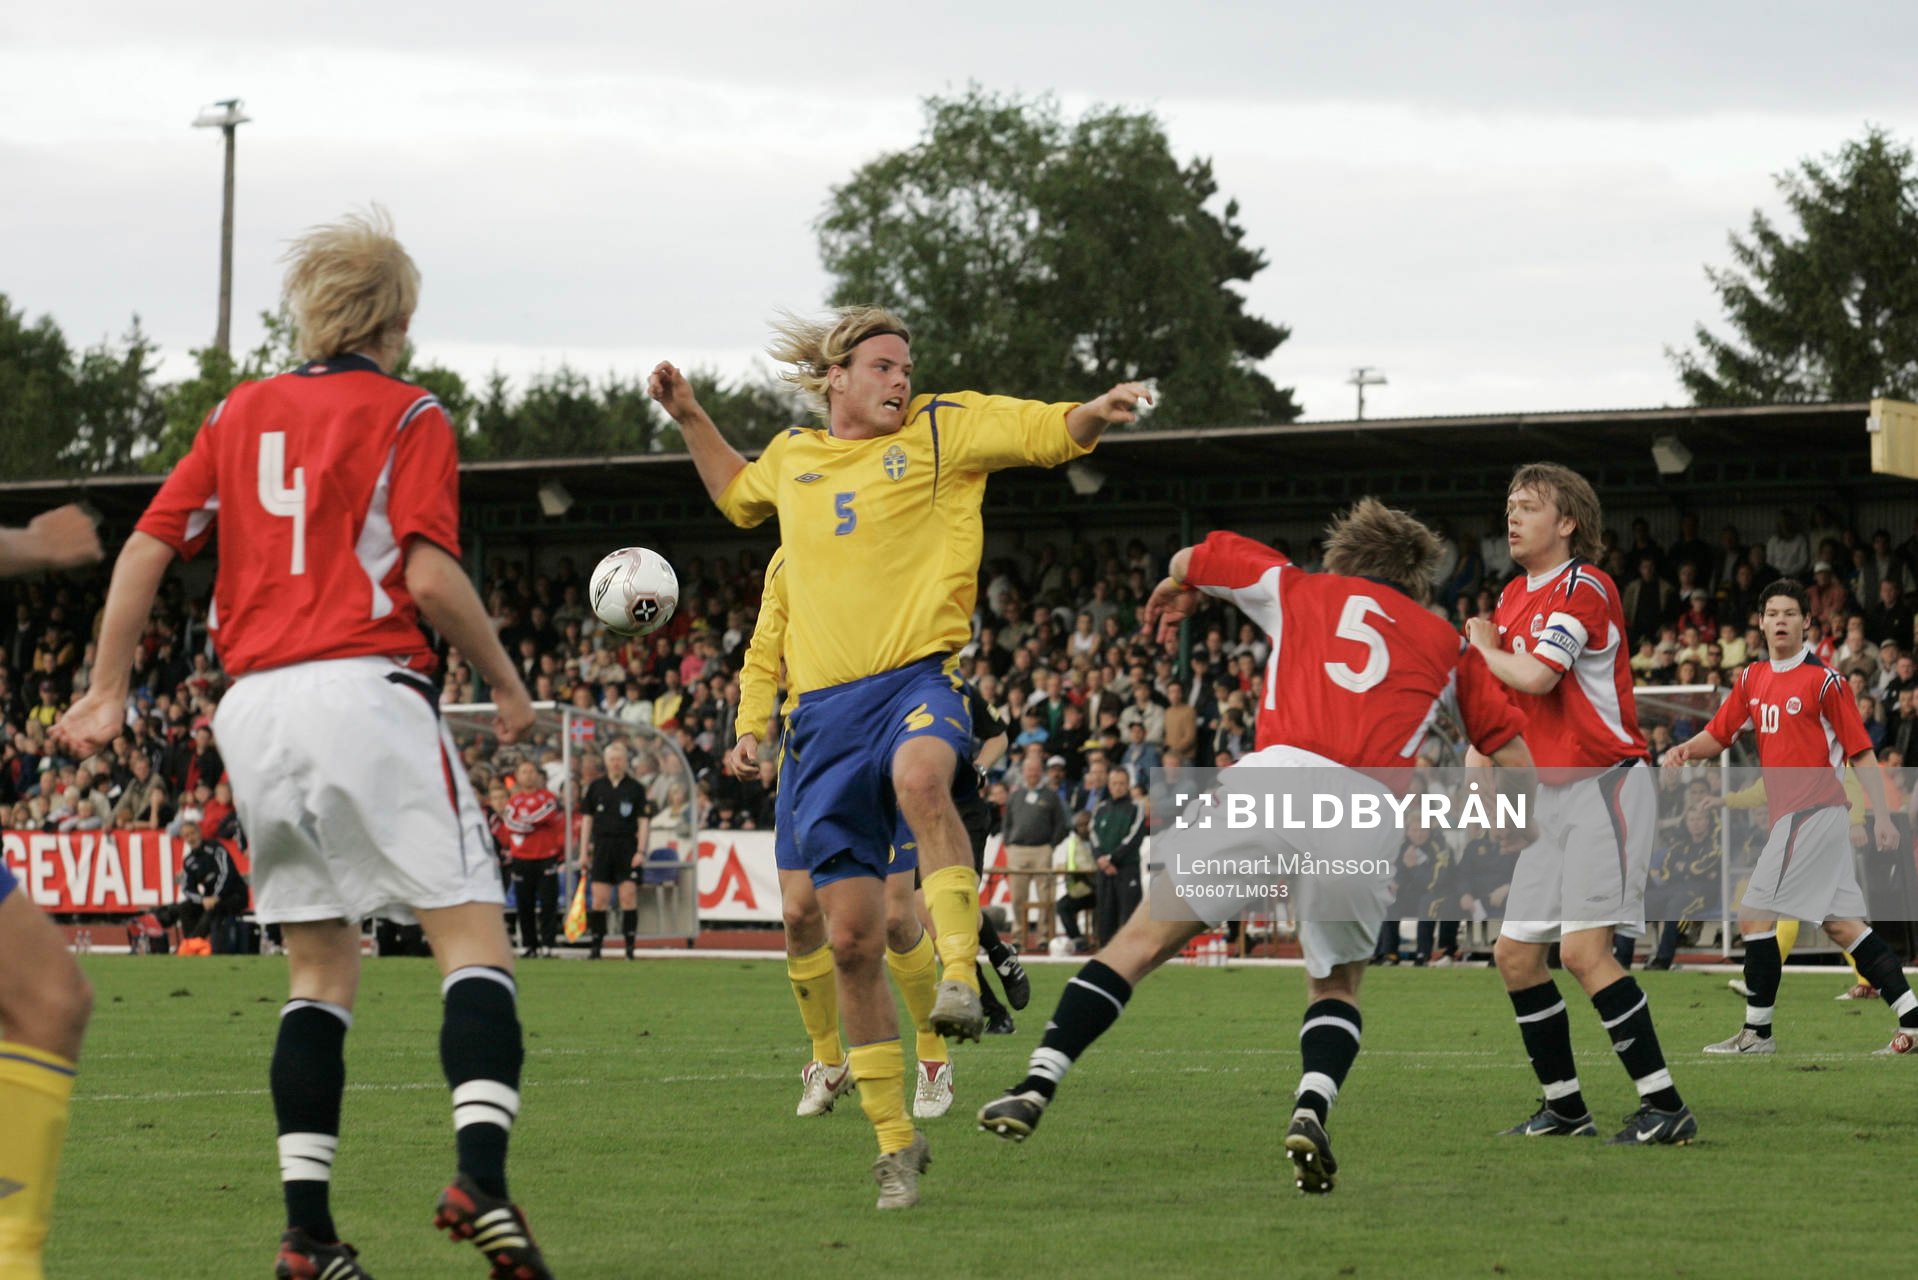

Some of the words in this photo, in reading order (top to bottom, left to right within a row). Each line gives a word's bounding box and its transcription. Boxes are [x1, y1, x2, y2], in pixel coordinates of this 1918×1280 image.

[257, 431, 306, 576] 4
[834, 491, 857, 536] 5
[1324, 594, 1396, 693] 5
[904, 703, 934, 732] 5
[1760, 703, 1780, 734] 10
[2, 833, 190, 906] GEVALI
